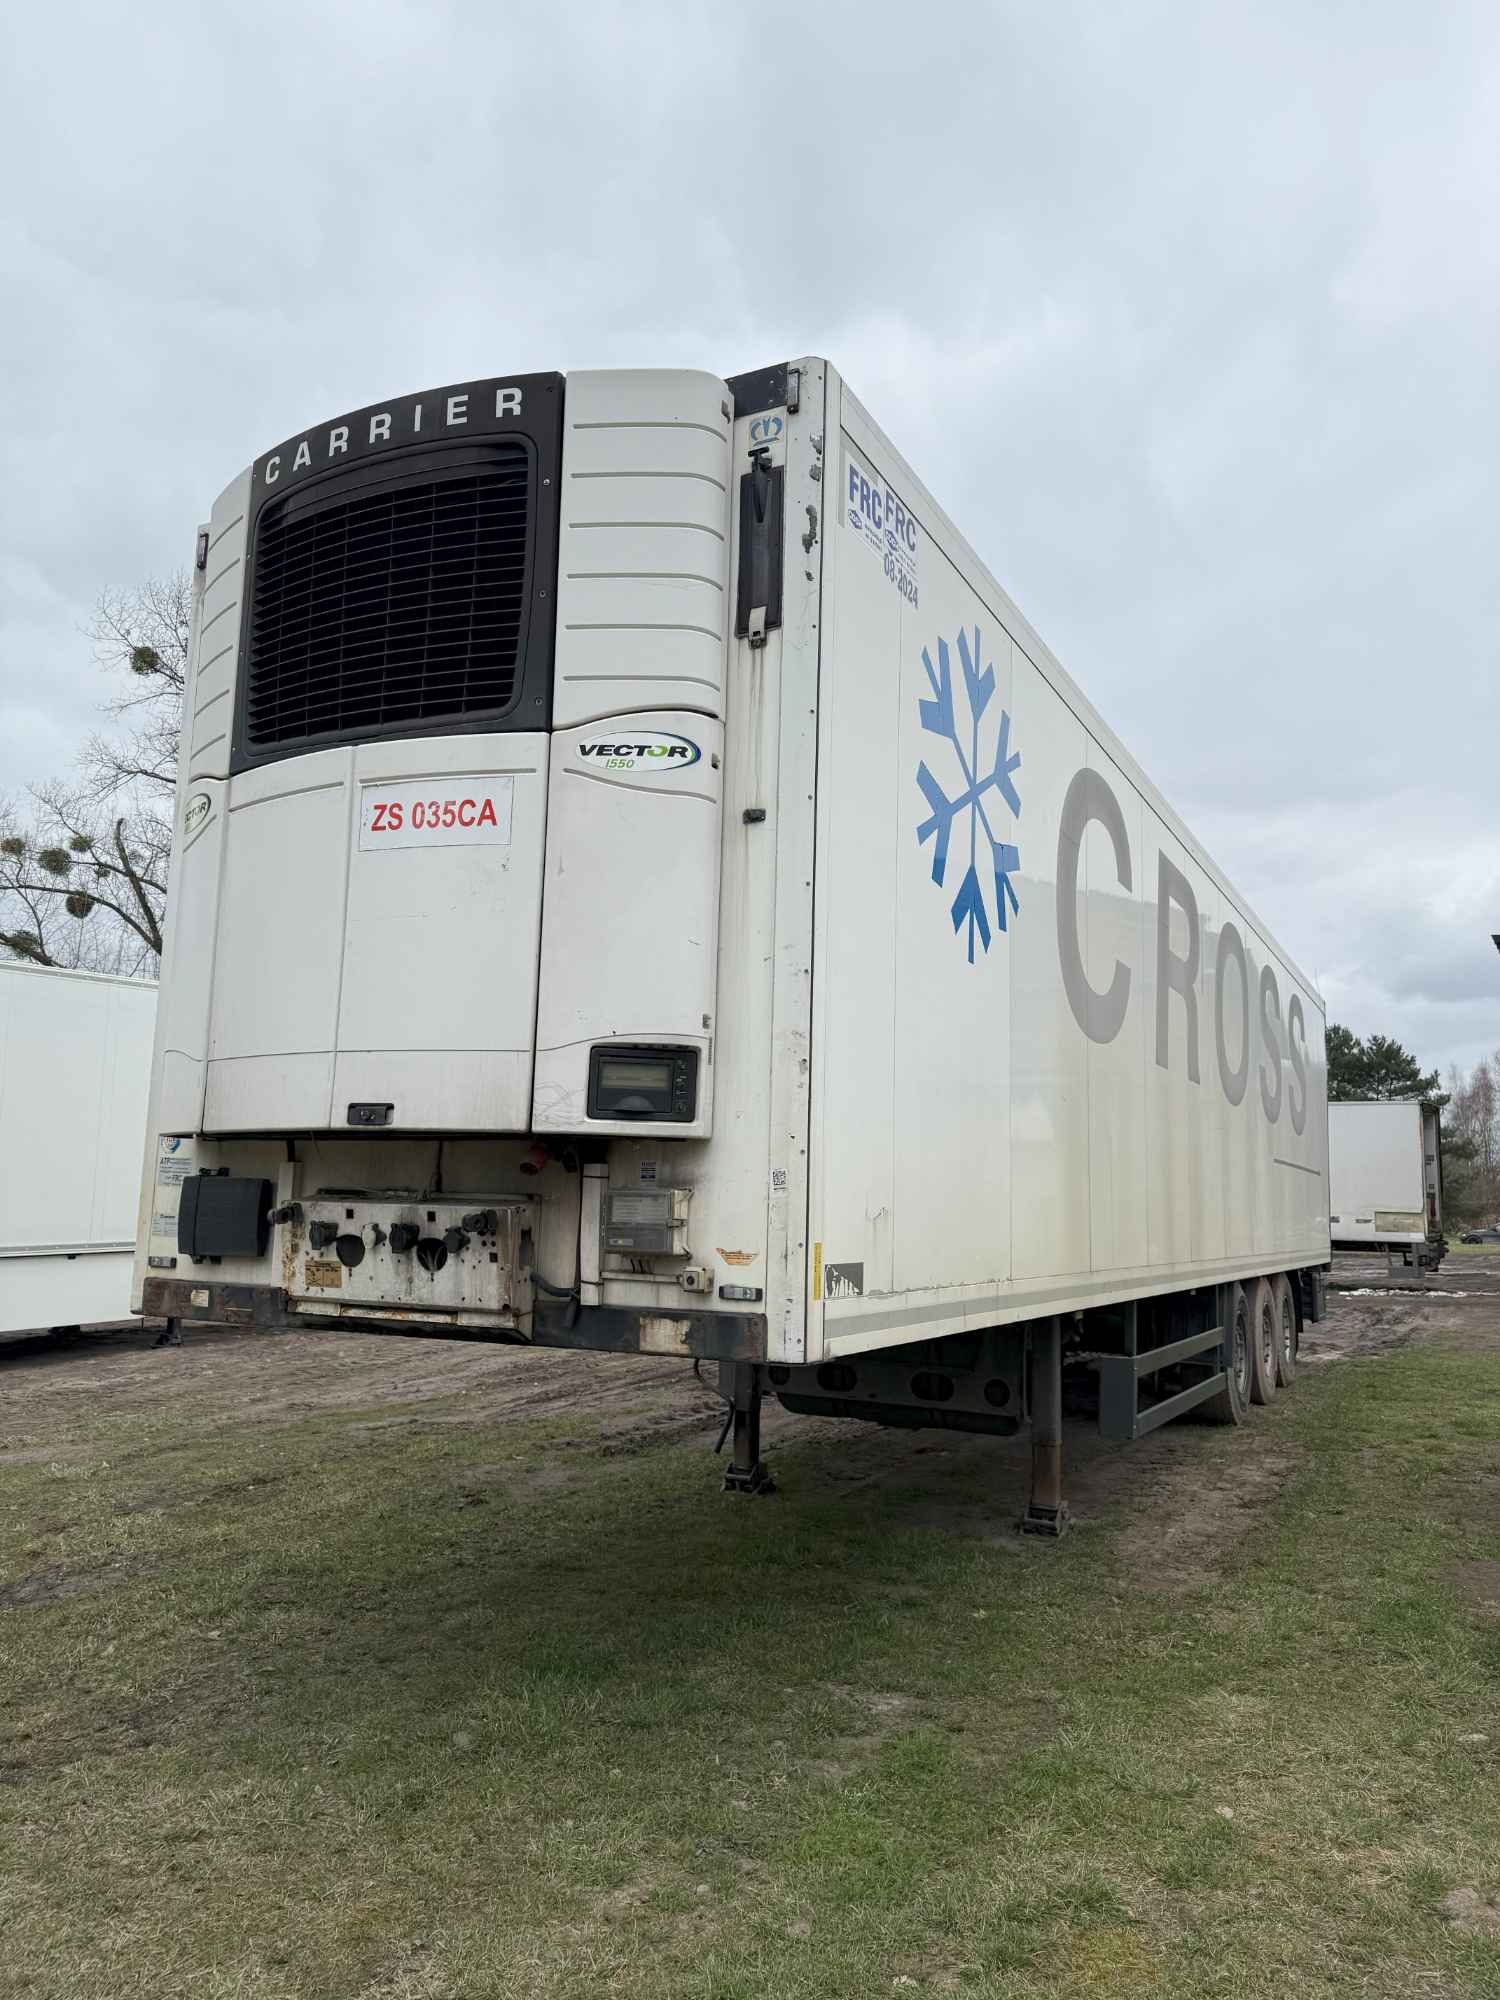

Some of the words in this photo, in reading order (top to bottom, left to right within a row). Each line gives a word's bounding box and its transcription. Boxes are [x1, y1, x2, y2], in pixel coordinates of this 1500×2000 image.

[265, 387, 523, 485] CARRIER
[848, 463, 882, 531] FRC
[885, 487, 917, 553] FRC
[884, 552, 919, 611] 08-2024
[579, 744, 689, 758] VECTOR
[371, 802, 404, 832] ZS
[411, 798, 498, 830] 035CA
[1056, 767, 1311, 1137] CROSS
